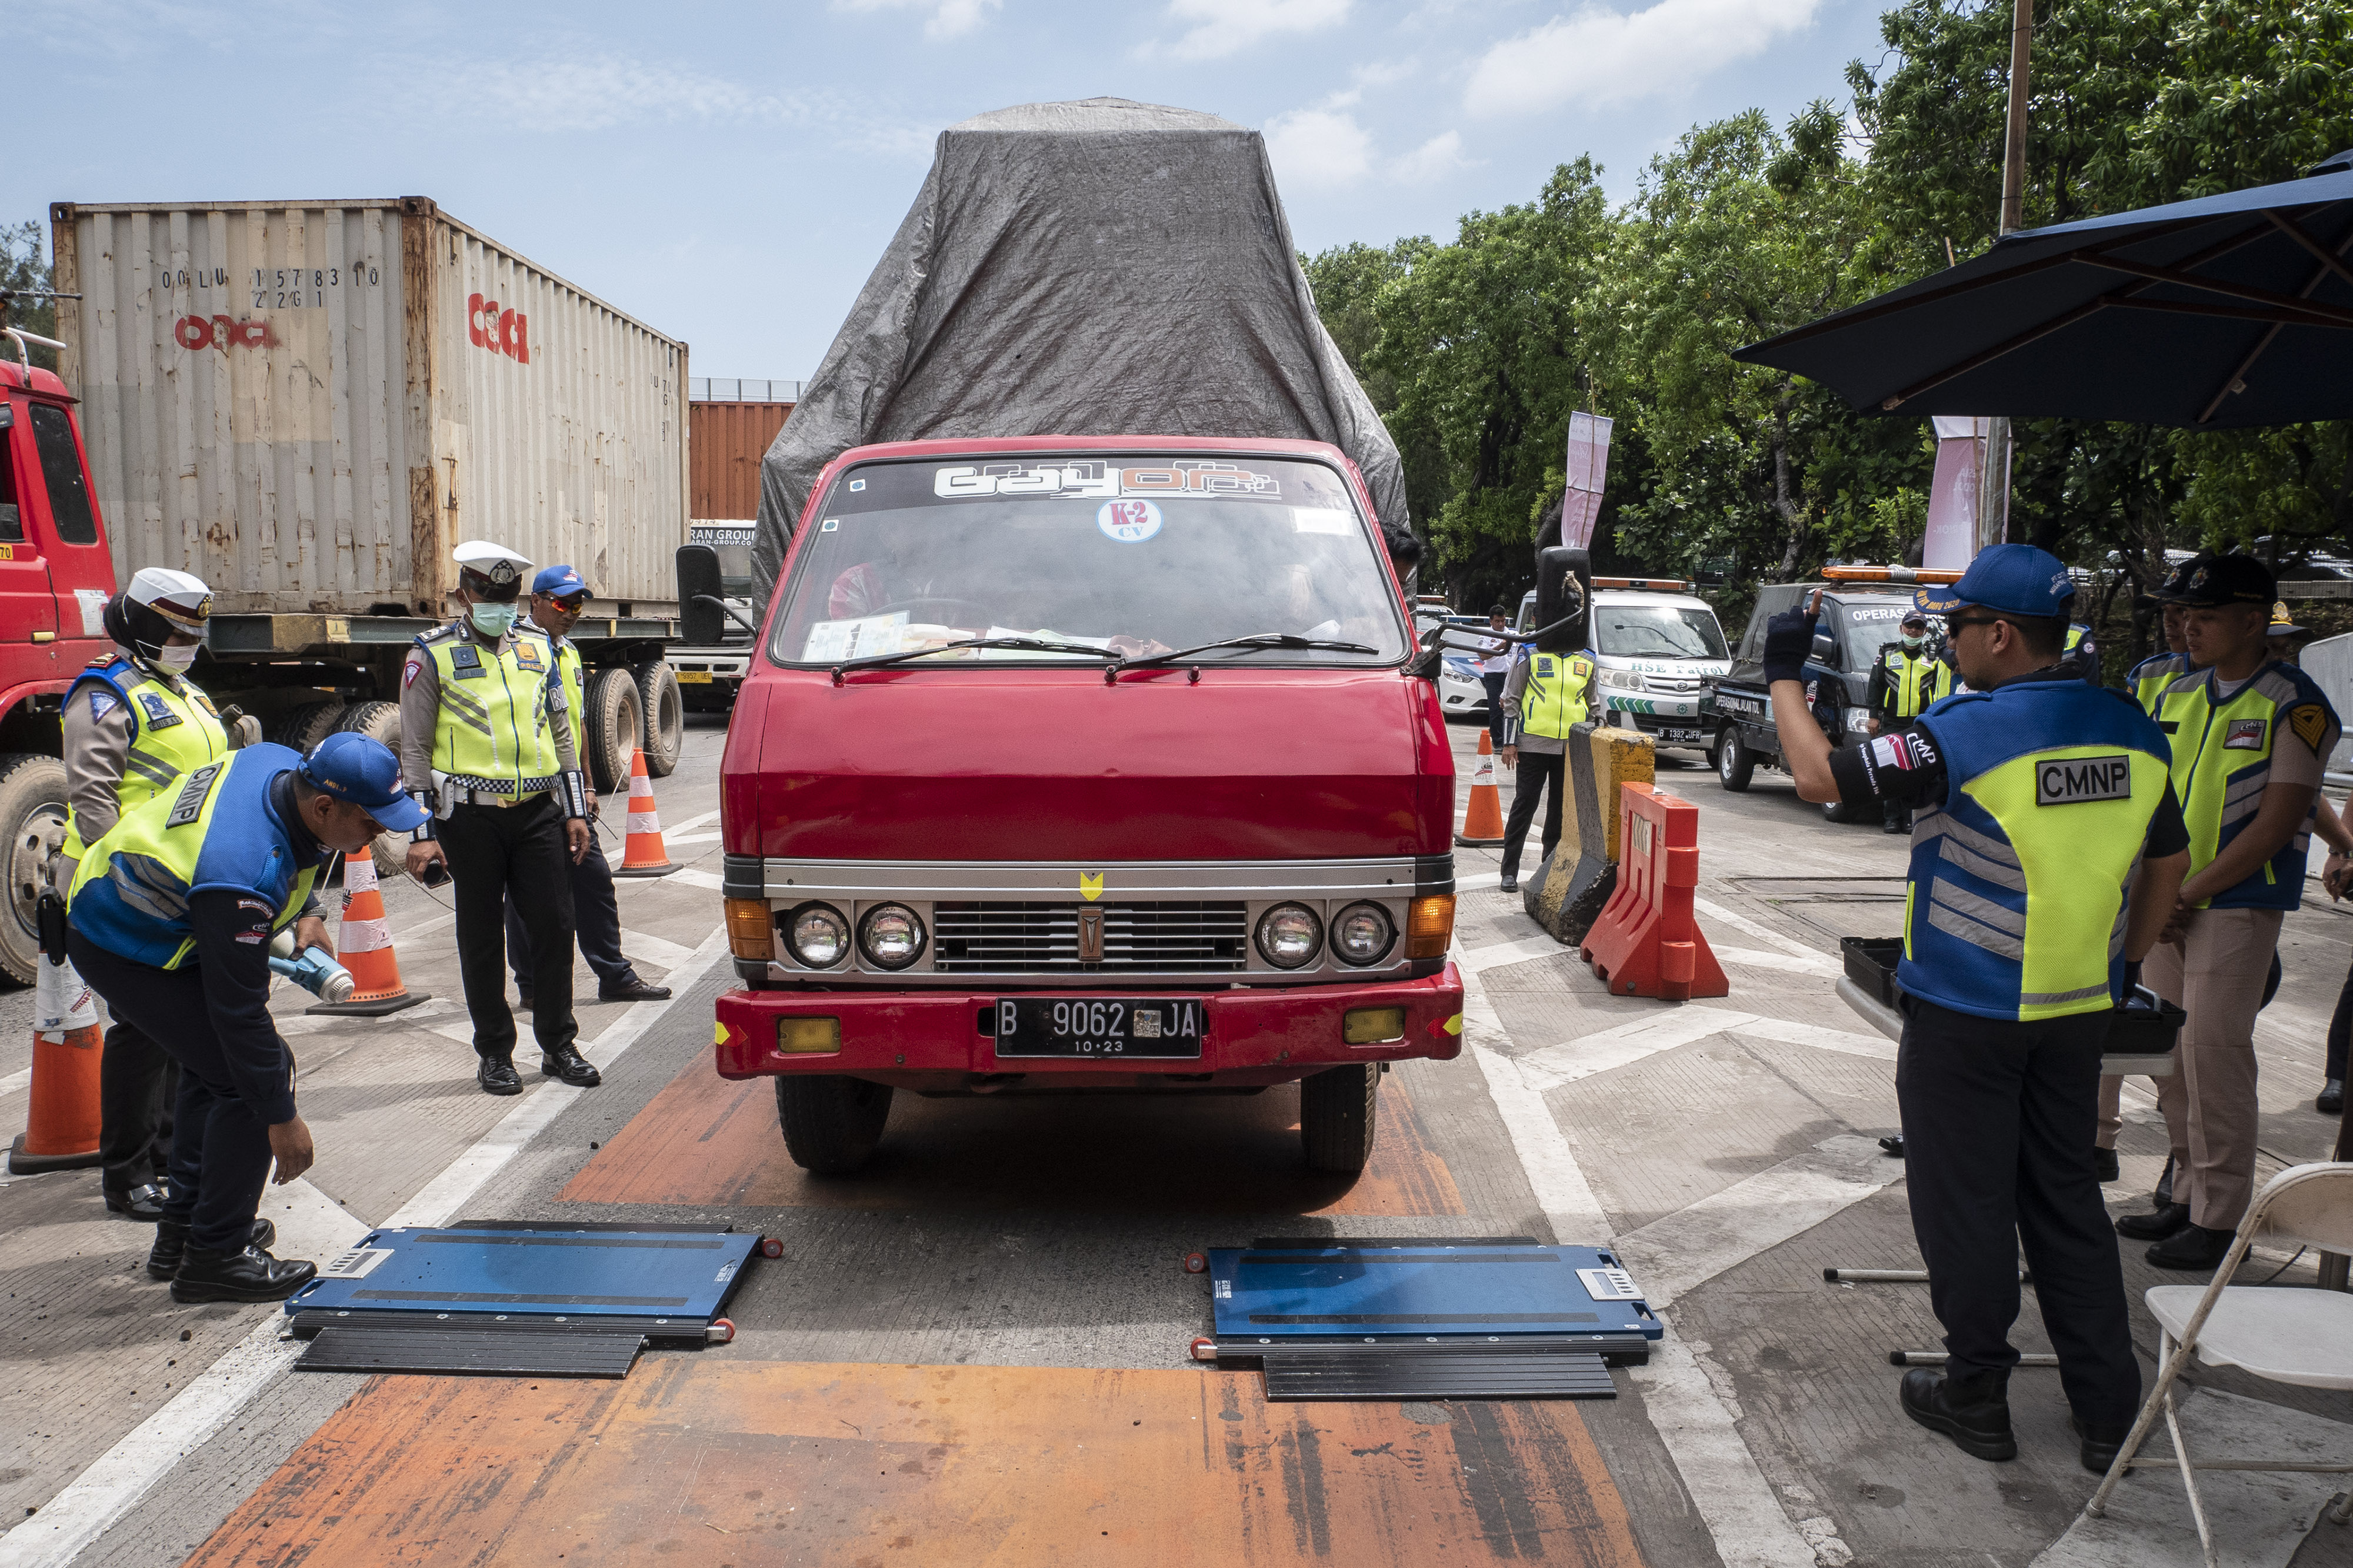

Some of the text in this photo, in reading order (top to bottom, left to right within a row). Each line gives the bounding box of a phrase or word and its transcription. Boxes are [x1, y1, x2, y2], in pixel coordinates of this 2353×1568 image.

[1111, 501, 1148, 526] K-2
[1119, 526, 1144, 538] CV
[1630, 662, 1667, 673] HSE
[1715, 695, 1759, 715] OPERASIONAL JALAN TOL
[1659, 729, 1664, 738] B
[1669, 729, 1685, 738] 1382
[2042, 762, 2127, 798] CMNP
[174, 767, 217, 820] CMNP
[1001, 1002, 1196, 1037] B 9062 JA
